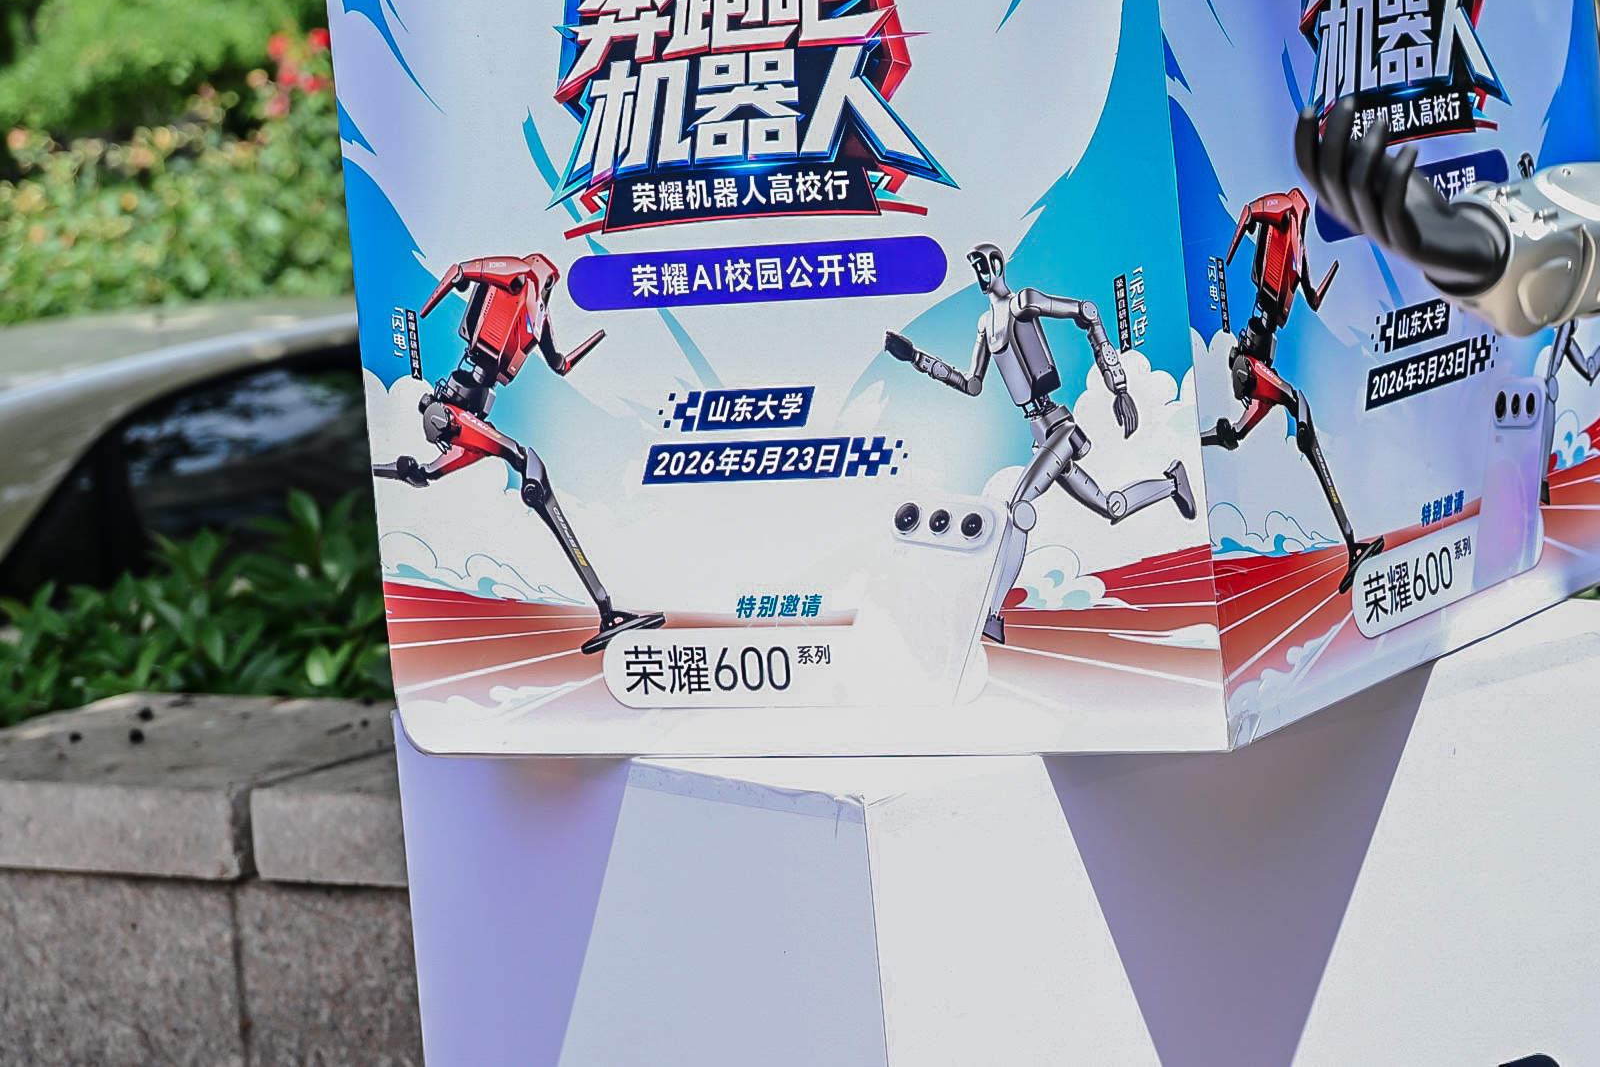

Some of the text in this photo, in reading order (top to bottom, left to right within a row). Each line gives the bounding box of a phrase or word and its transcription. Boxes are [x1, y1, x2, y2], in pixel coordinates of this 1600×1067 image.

[574, 44, 928, 180] 机器人
[631, 169, 850, 214] 荣耀机器人高校行
[631, 254, 878, 299] 荣耀AI校园公开课
[1397, 303, 1447, 339] 山东大学
[1371, 343, 1467, 401] 2026年5月23日
[706, 392, 803, 425] 山东大学
[652, 442, 840, 478] 2026年5月23日
[1420, 489, 1465, 528] 特别邀请
[1363, 536, 1473, 625] 荣耀600 系列
[735, 594, 823, 619] 特别邀请
[623, 644, 831, 696] 荣耀600 系列
